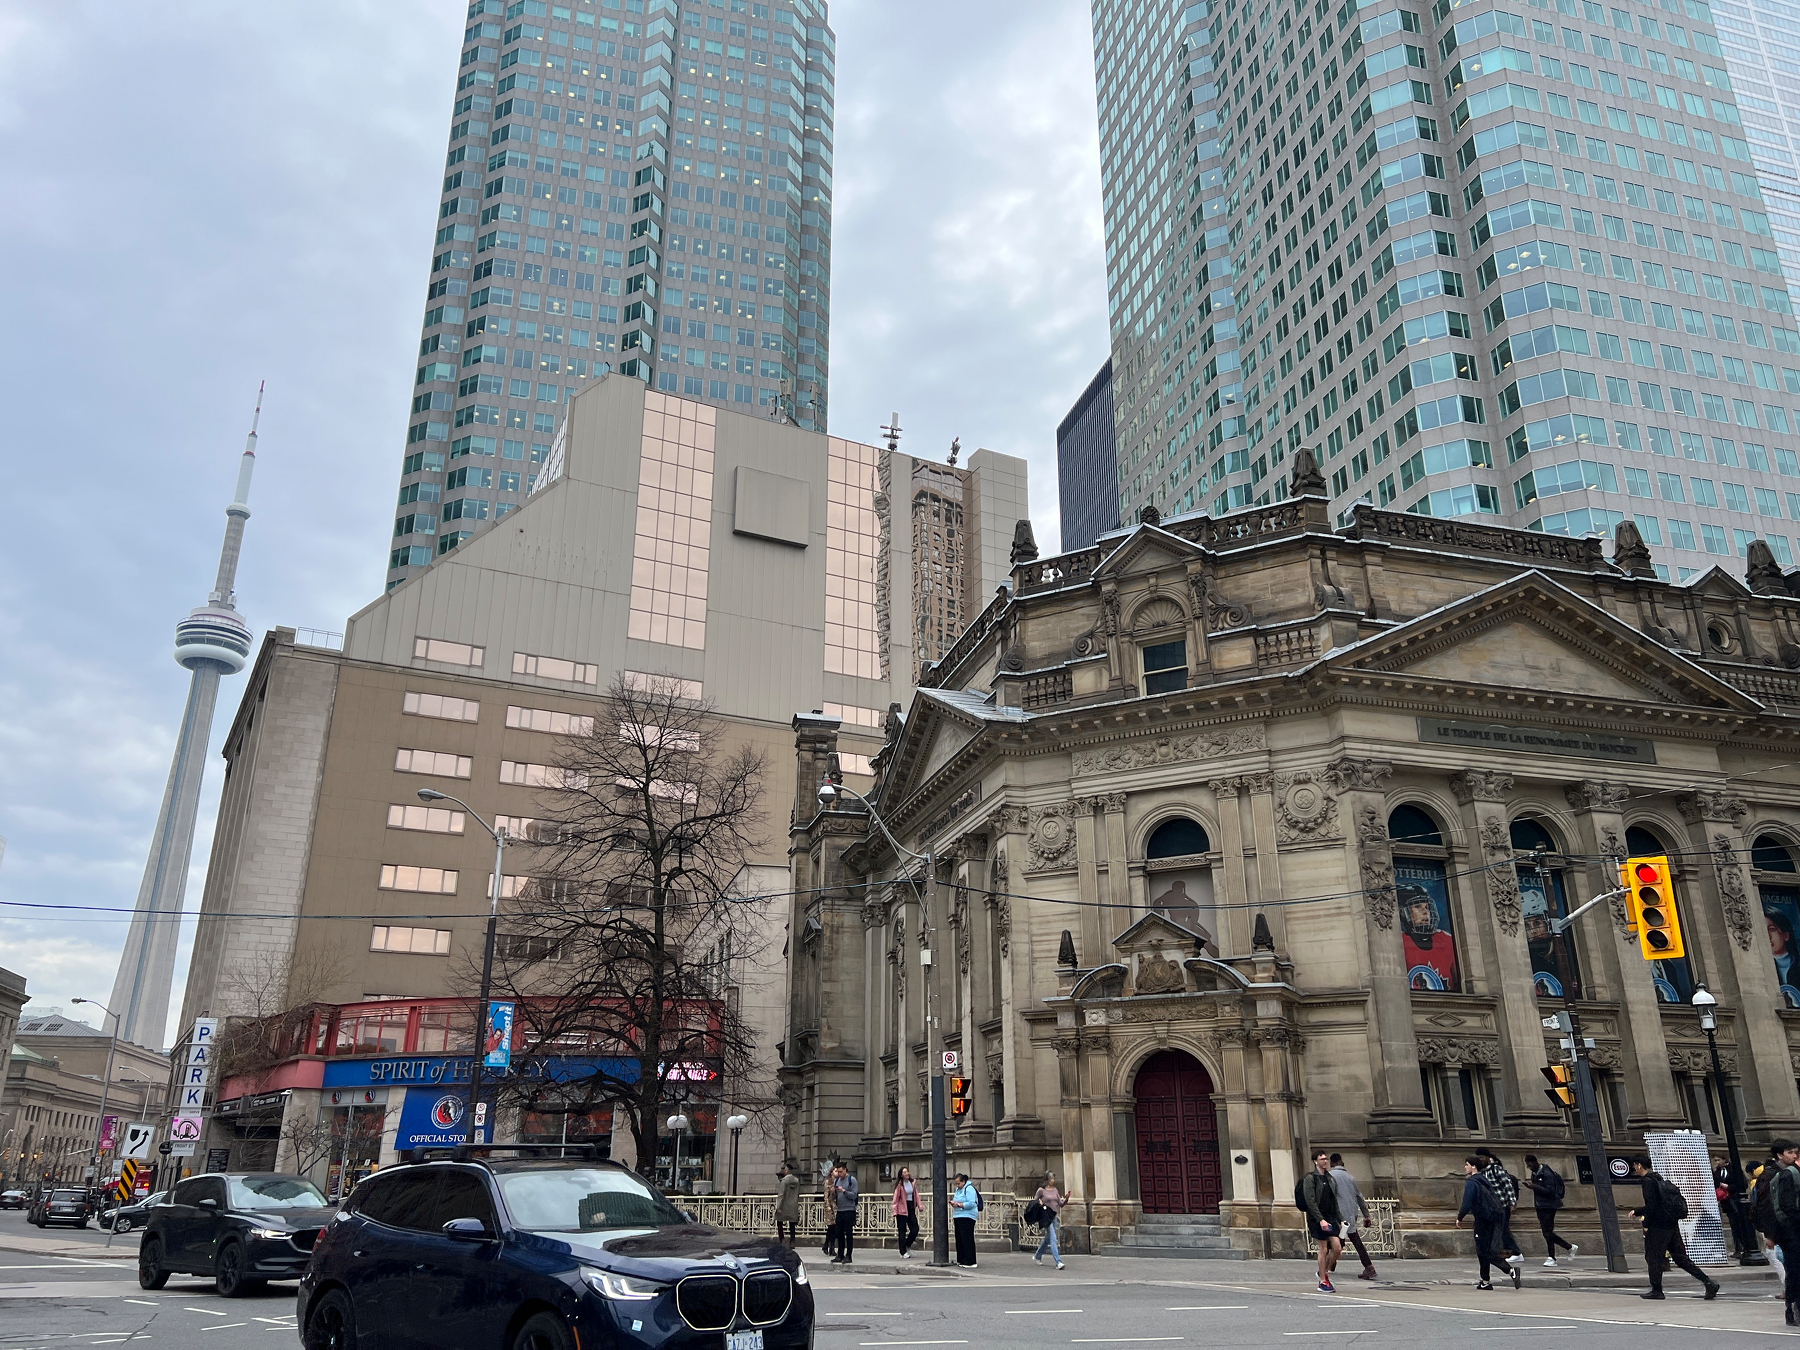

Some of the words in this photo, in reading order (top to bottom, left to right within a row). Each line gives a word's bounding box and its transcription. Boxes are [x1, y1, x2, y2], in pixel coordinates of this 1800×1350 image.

[1437, 727, 1449, 737] LE
[1450, 728, 1491, 741] TEMPLE
[1493, 732, 1507, 742] DE
[1509, 733, 1522, 744] LA
[187, 1027, 210, 1104] PARK
[370, 1061, 429, 1080] SPIRIT
[430, 1060, 451, 1084] of
[409, 1134, 446, 1143] OFFICIAL
[1613, 1163, 1626, 1171] Esso
[749, 1336, 763, 1349] 243
